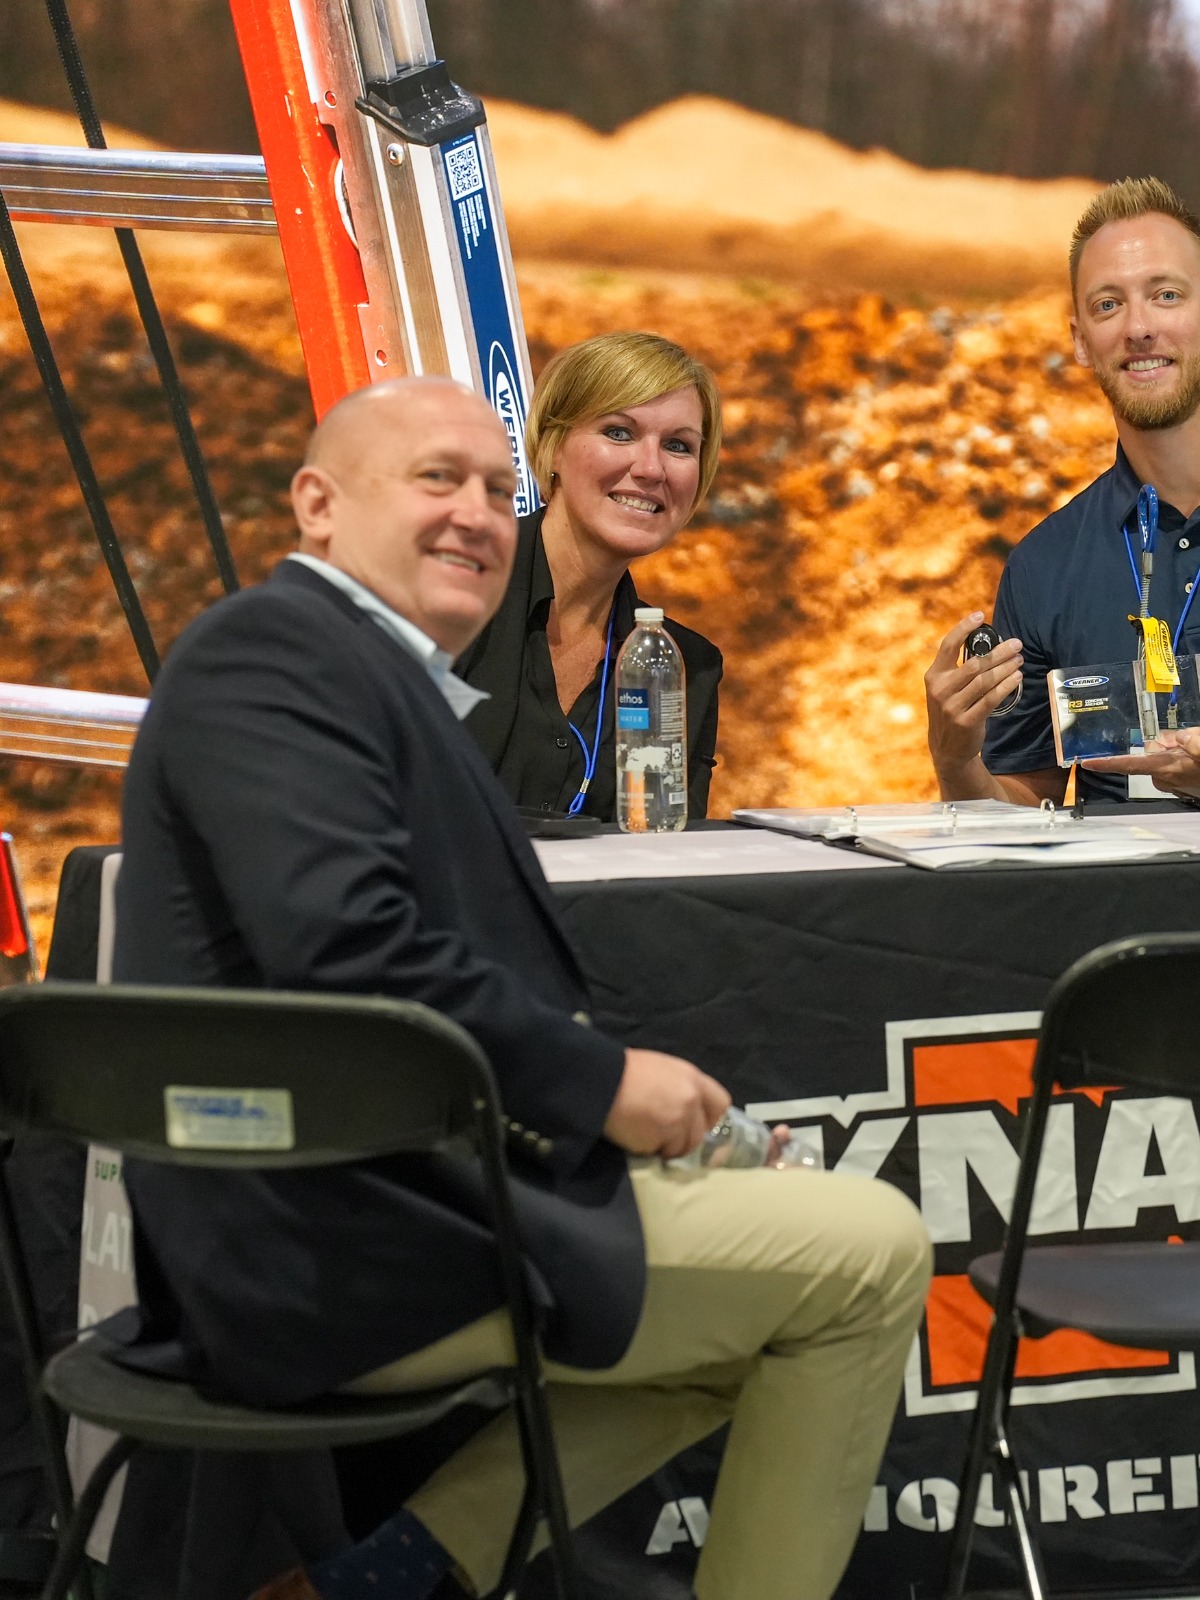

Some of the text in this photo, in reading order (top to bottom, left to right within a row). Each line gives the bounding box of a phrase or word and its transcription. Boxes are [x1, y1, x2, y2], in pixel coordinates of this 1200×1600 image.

[1072, 678, 1100, 686] WERNER
[619, 692, 643, 704] ethos
[1068, 699, 1083, 708] R3
[95, 1160, 123, 1183] SUP
